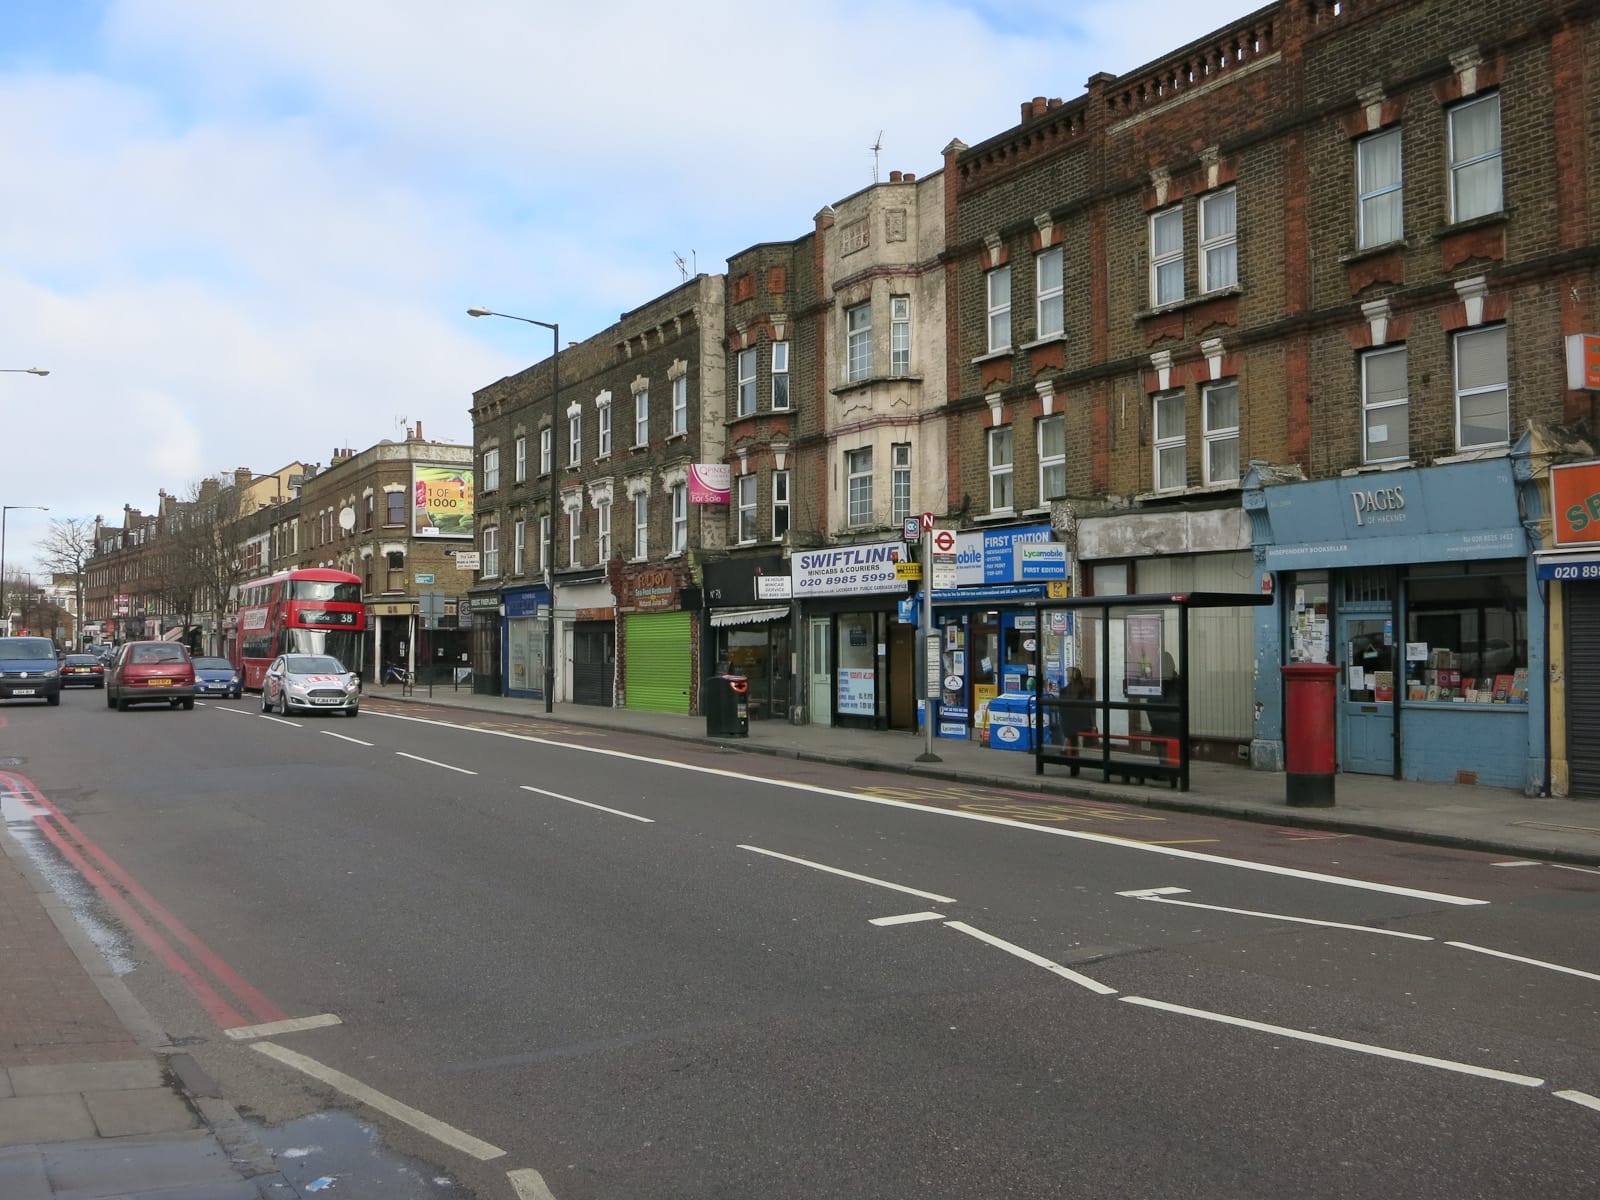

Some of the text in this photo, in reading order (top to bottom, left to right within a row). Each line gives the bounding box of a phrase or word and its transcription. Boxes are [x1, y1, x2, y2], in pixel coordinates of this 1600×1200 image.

[428, 489, 449, 497] 1 OF
[692, 494, 721, 503] For Sale
[428, 499, 457, 508] 1000
[1352, 486, 1405, 526] PAGES
[924, 515, 933, 527] N
[1368, 514, 1407, 524] OF HACKNEY
[985, 532, 1049, 548] FIRST EDITION
[1024, 550, 1063, 559] Lycamobile
[1269, 545, 1348, 556] INDEPENDENT BOOKSELLER
[801, 546, 900, 570] SWIFTLINE
[808, 568, 838, 576] MINICABS
[846, 565, 880, 573] COURIERS
[1555, 566, 1600, 579] 020 89
[801, 572, 895, 587] 020 8985 5999
[341, 614, 353, 623] 38
